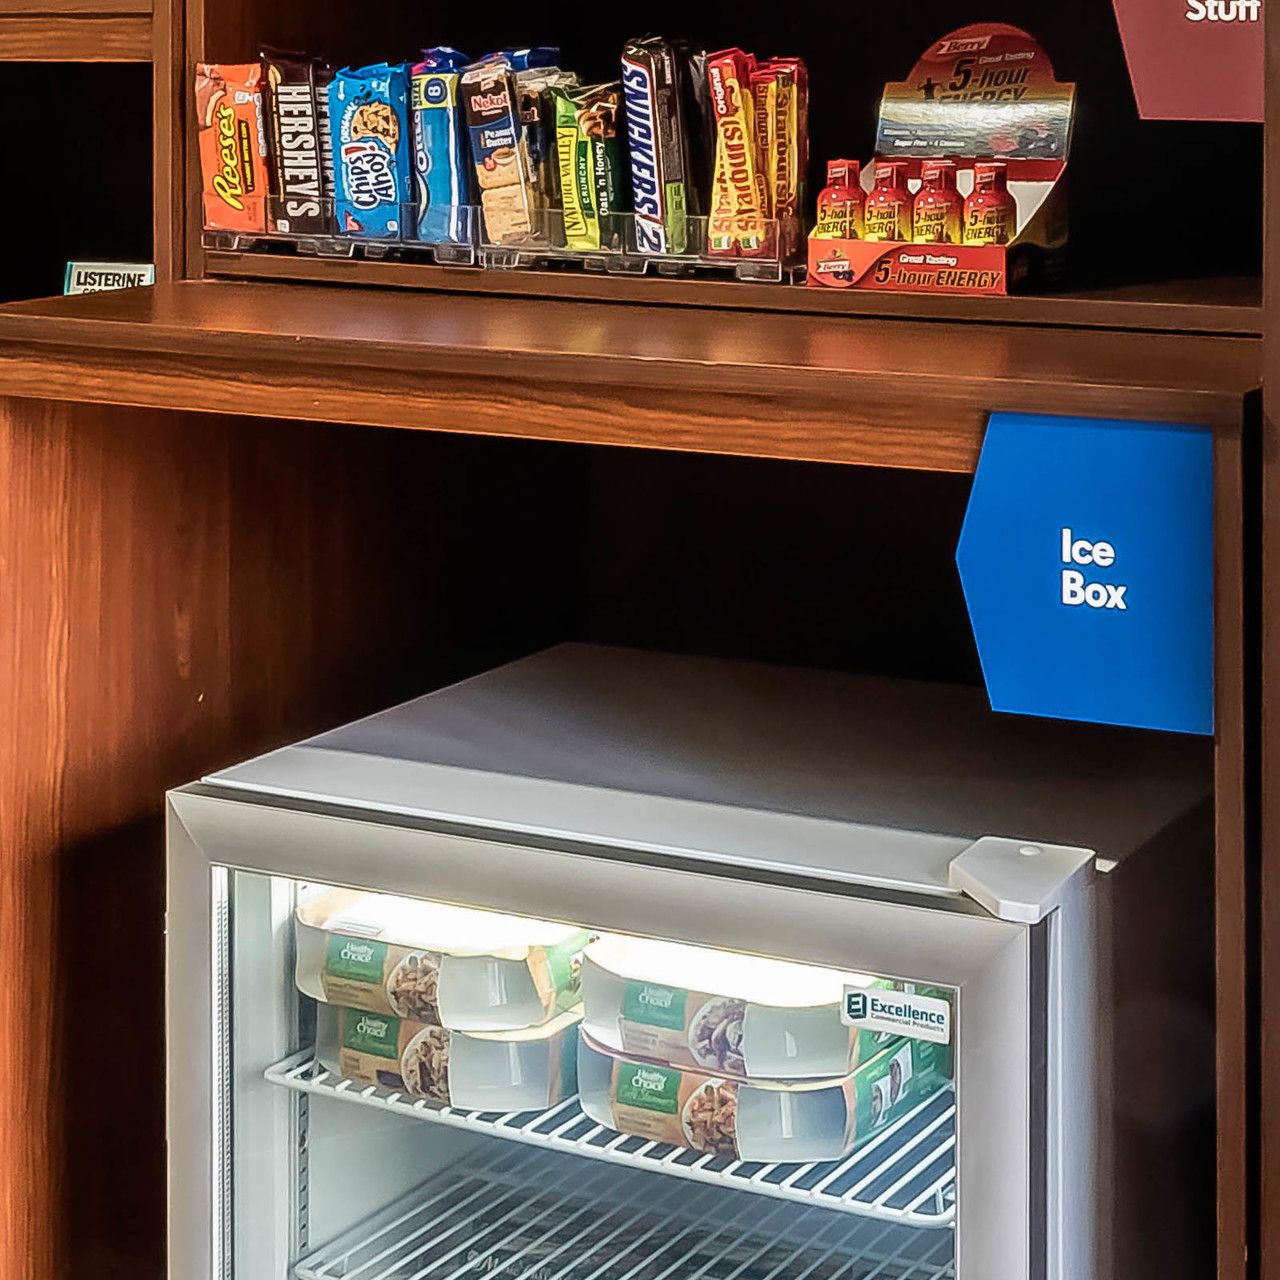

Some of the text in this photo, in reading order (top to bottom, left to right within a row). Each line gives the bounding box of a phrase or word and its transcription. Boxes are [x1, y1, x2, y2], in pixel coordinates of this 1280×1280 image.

[947, 38, 986, 52] Berry
[948, 58, 1030, 92] 5-hour
[340, 102, 357, 143] ORIGINAL
[471, 96, 509, 110] Nekot
[213, 103, 245, 211] Reese's
[277, 85, 320, 218] HERSHEY'S
[594, 141, 606, 177] Honey
[622, 65, 662, 217] SNICKERS
[349, 156, 379, 209] Chips
[559, 128, 585, 236] NATURE VALLEY
[578, 156, 591, 205] CRUNCHY
[723, 118, 759, 232] Starburst
[599, 191, 611, 217] Oats
[76, 270, 147, 289] LISTERINE
[875, 259, 1000, 287] 5-hour ENERGY
[1062, 528, 1115, 567] Ice
[1062, 570, 1127, 610] Box
[871, 998, 944, 1025] Excellence
